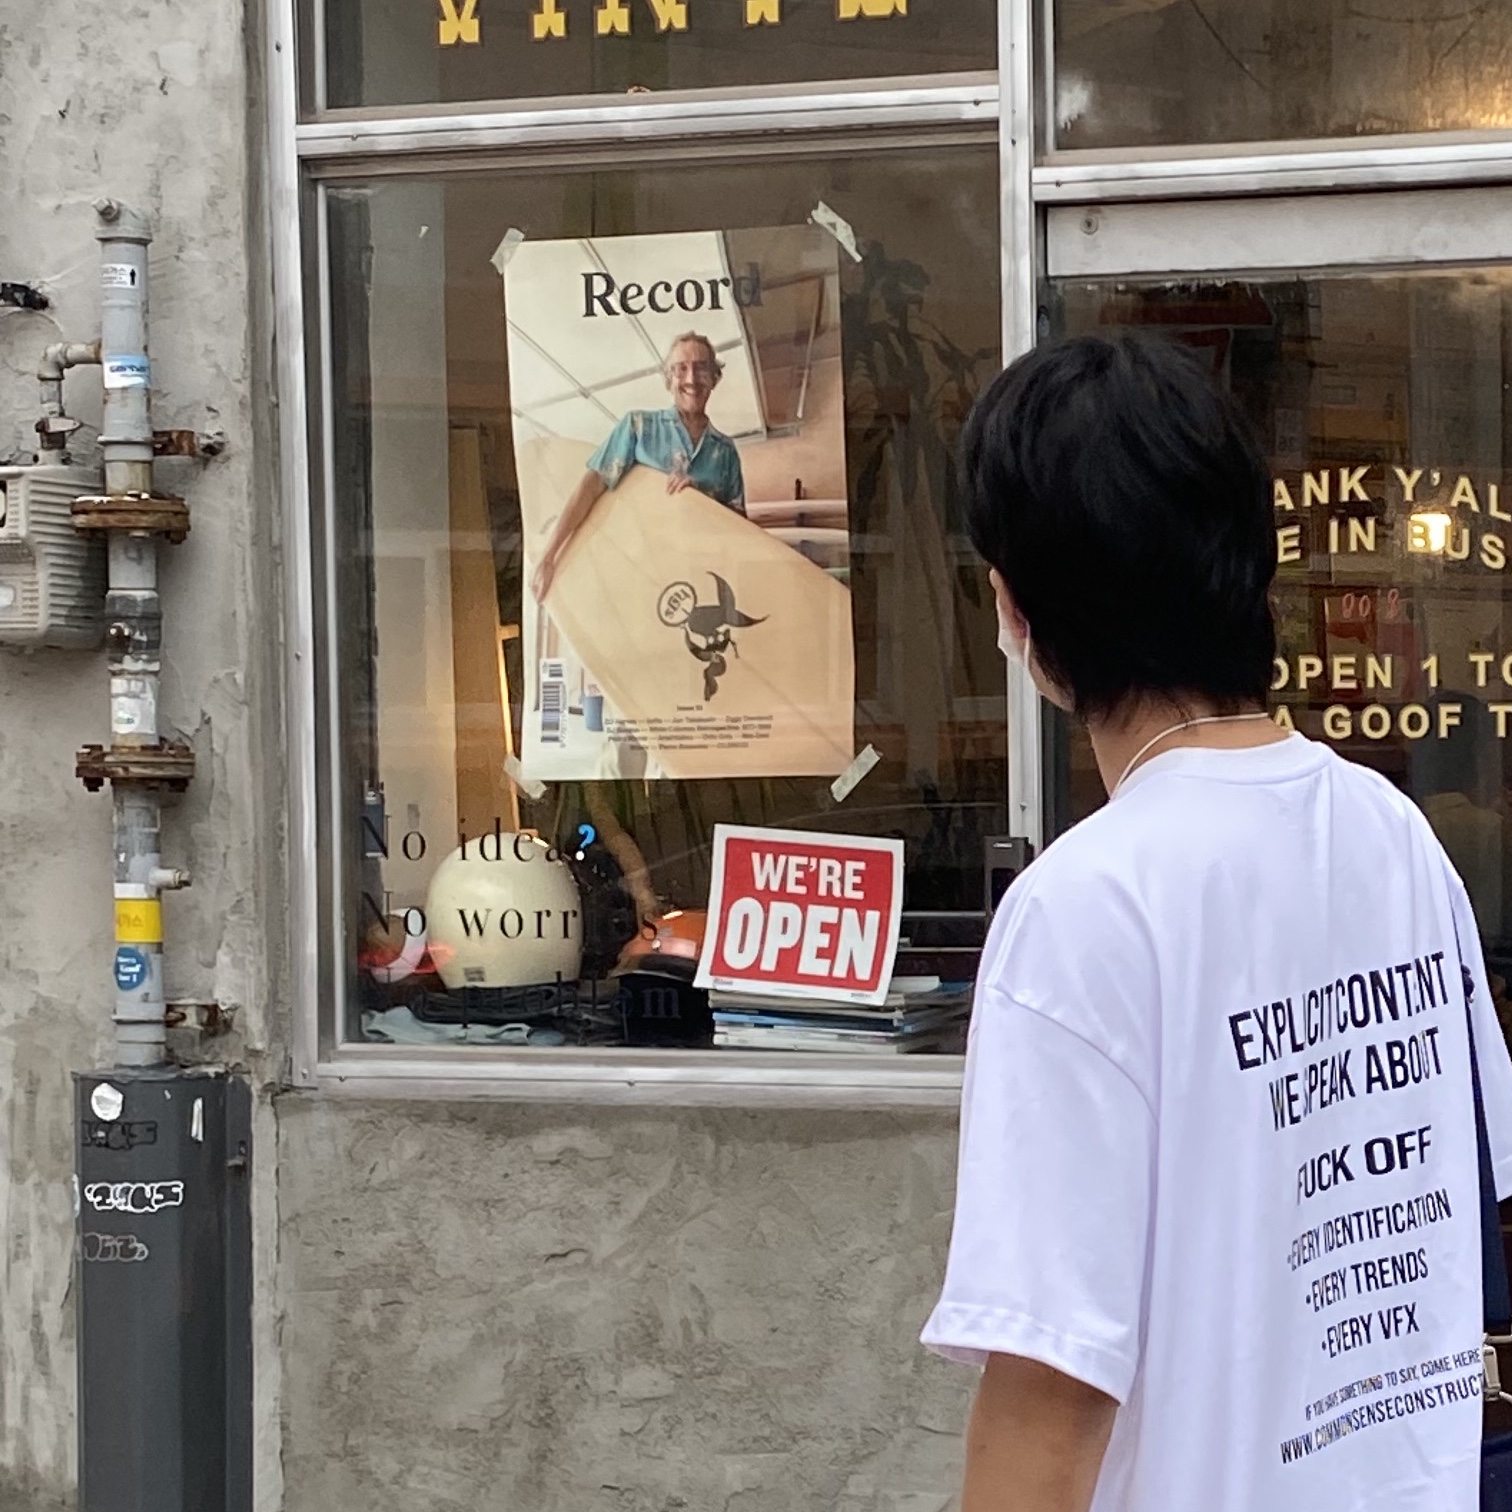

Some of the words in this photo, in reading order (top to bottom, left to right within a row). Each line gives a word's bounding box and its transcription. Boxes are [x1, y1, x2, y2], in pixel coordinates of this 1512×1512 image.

[581, 261, 763, 318] Record
[1273, 465, 1373, 512] ANK
[1329, 516, 1375, 553] IN
[1422, 654, 1439, 688] 1
[1323, 703, 1462, 740] GOOF
[362, 815, 426, 861] No
[751, 852, 866, 900] WE'RE
[362, 890, 427, 938] No
[723, 896, 881, 981] OPEN
[1228, 951, 1448, 1071] EXPLICITCONTNT
[1269, 1073, 1301, 1131] WE
[1366, 1026, 1441, 1094] ABOUT
[1297, 1144, 1355, 1206] FUCK
[1364, 1125, 1431, 1175] OFF
[1322, 1188, 1452, 1253] IDENTIFICATION
[1351, 1248, 1428, 1294] TRENDS
[1378, 1302, 1419, 1340] VFX
[1384, 1371, 1398, 1387] TO
[1421, 1356, 1452, 1378] COME
